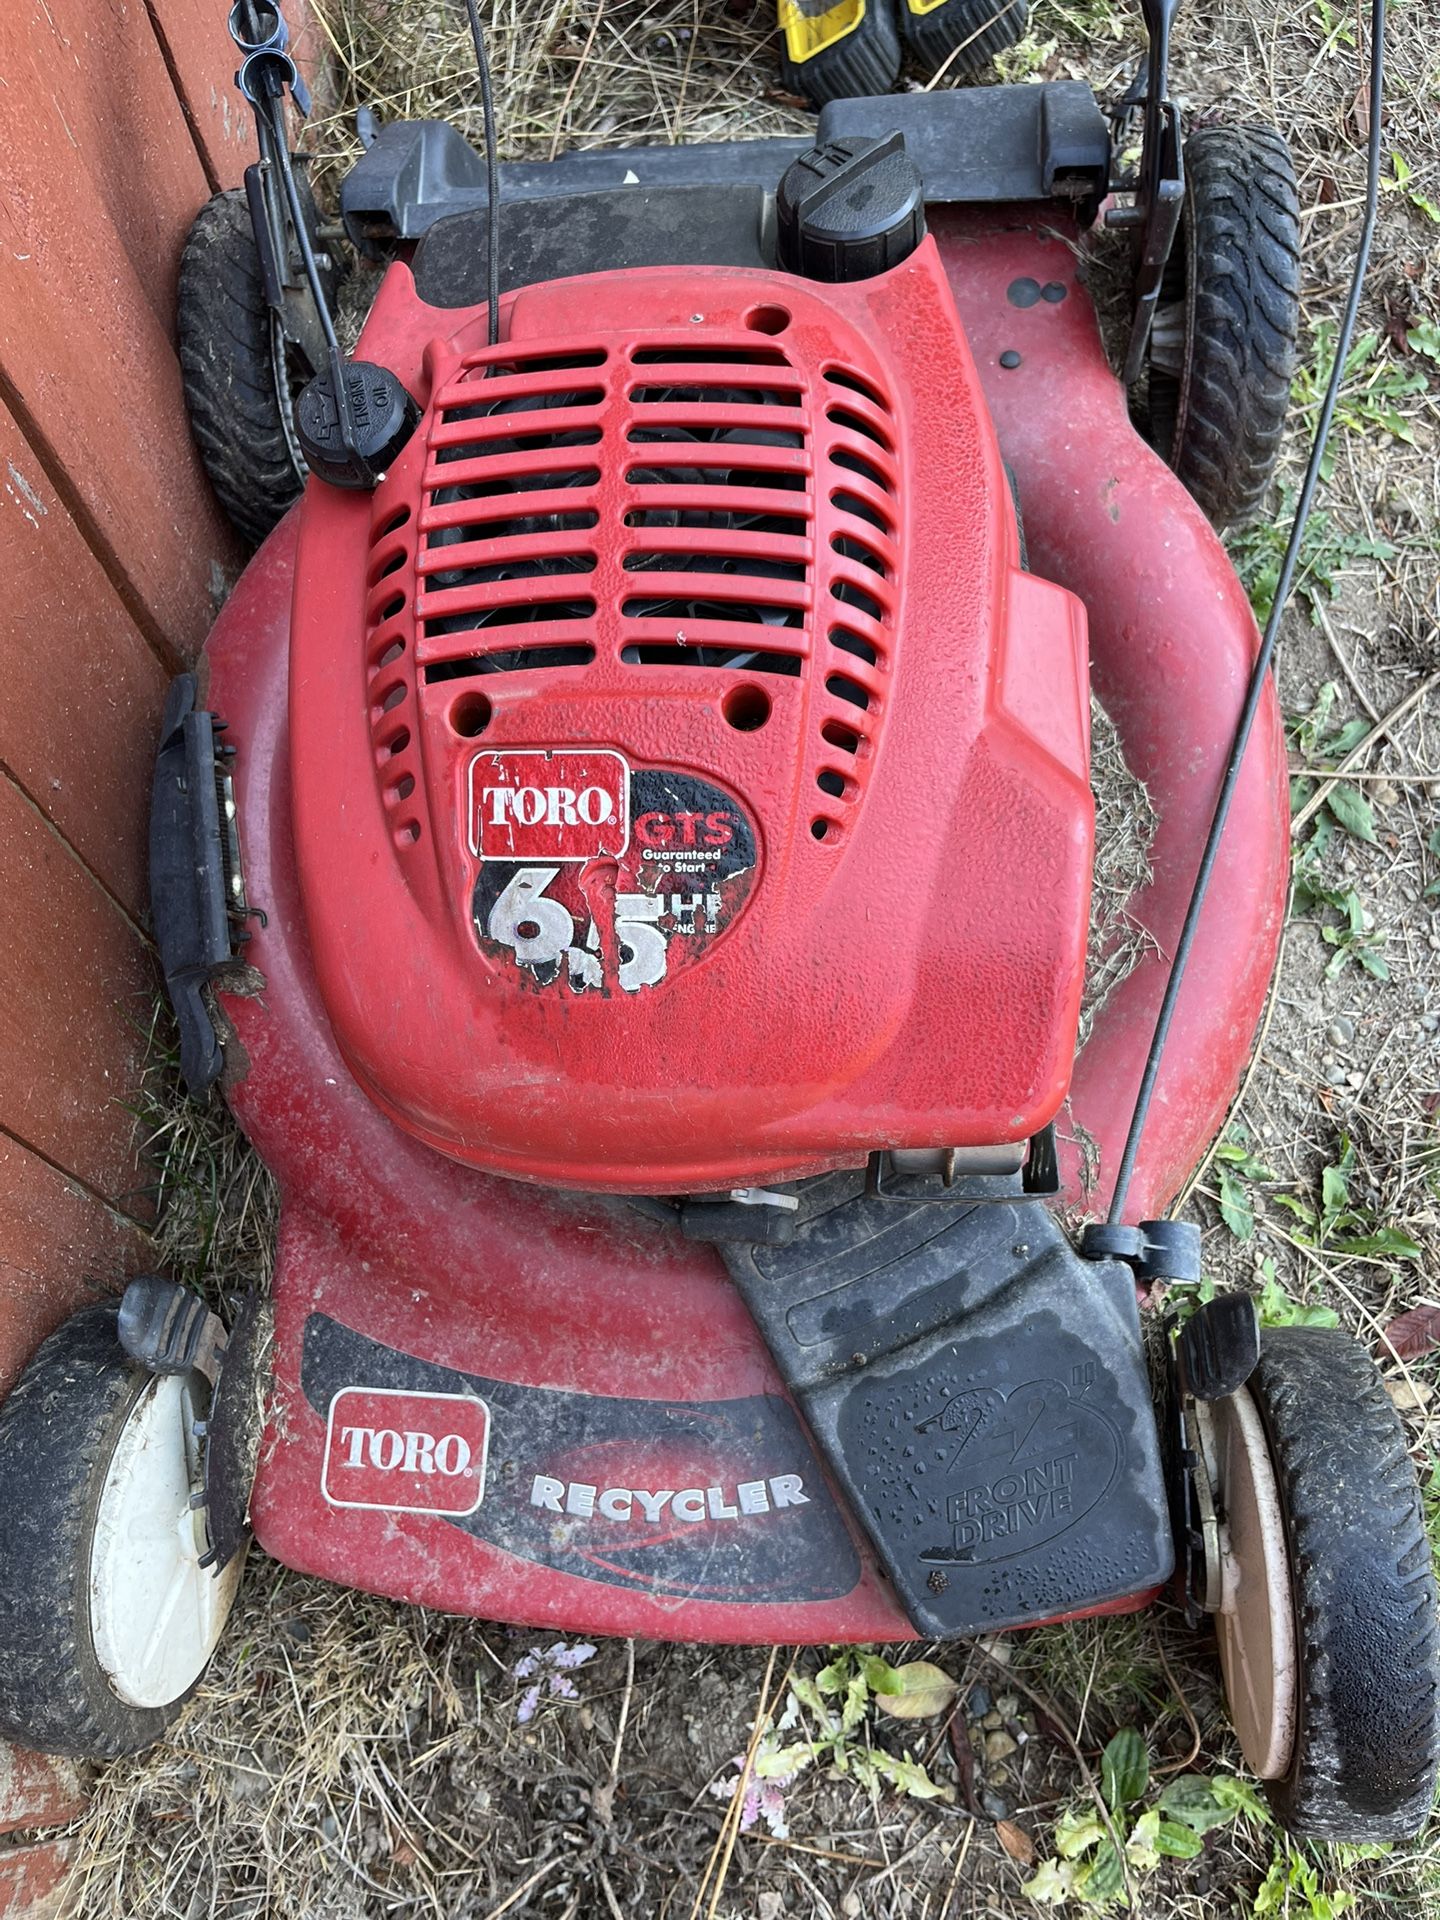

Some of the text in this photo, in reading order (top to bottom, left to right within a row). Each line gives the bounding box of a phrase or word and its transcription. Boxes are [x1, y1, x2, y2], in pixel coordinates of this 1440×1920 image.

[372, 384, 389, 408] OIL
[633, 810, 734, 846] GTS
[642, 848, 721, 861] Guaranteed
[674, 861, 706, 873] Start
[530, 1473, 812, 1523] RECYCLER
[946, 1452, 1078, 1524] FRONT
[951, 1485, 1073, 1551] DRIVE
